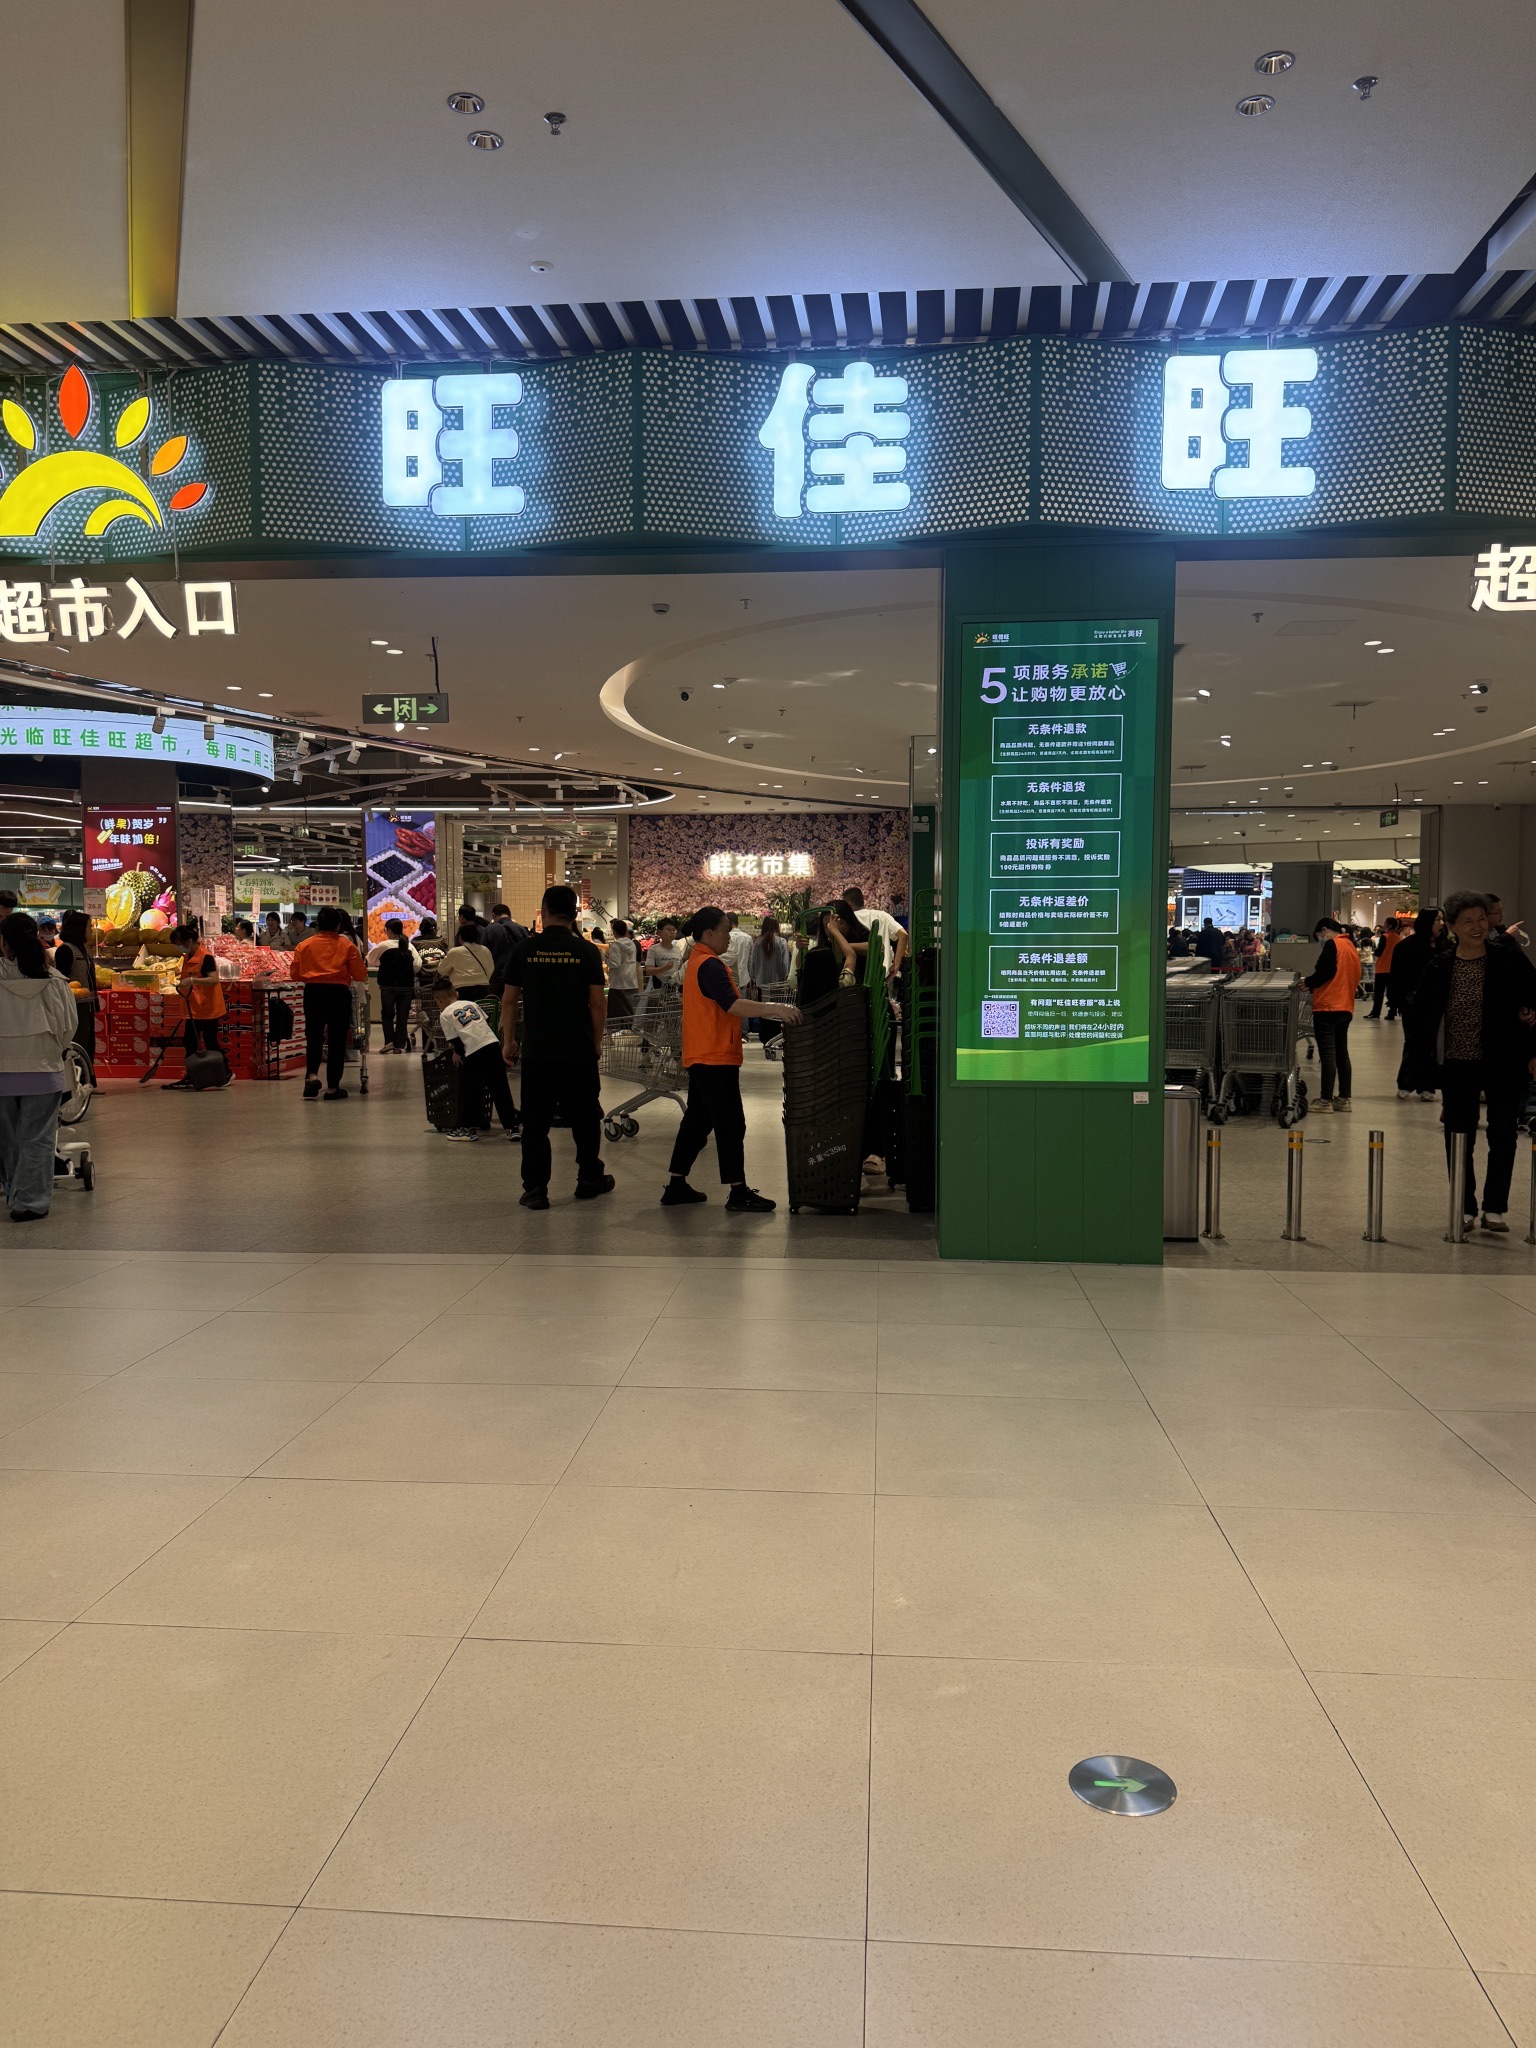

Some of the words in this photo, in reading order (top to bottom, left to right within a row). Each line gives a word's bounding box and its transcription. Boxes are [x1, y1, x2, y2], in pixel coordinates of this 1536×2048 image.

[381, 348, 1318, 519] 旺佳旺
[0, 576, 237, 643] 超市入口
[1013, 663, 1109, 681] 项服务承诺
[980, 667, 1008, 704] 5
[1011, 685, 1126, 703] 让购物更放心
[1028, 723, 1087, 735] 无条件退款
[1027, 781, 1086, 793] 无条件退货
[1026, 837, 1085, 849] 投诉有奖励
[709, 853, 812, 876] 鲜花市集
[1019, 896, 1089, 907] 无条件返差价
[1018, 952, 1089, 964] 无条件退差额
[453, 1004, 481, 1027] 23
